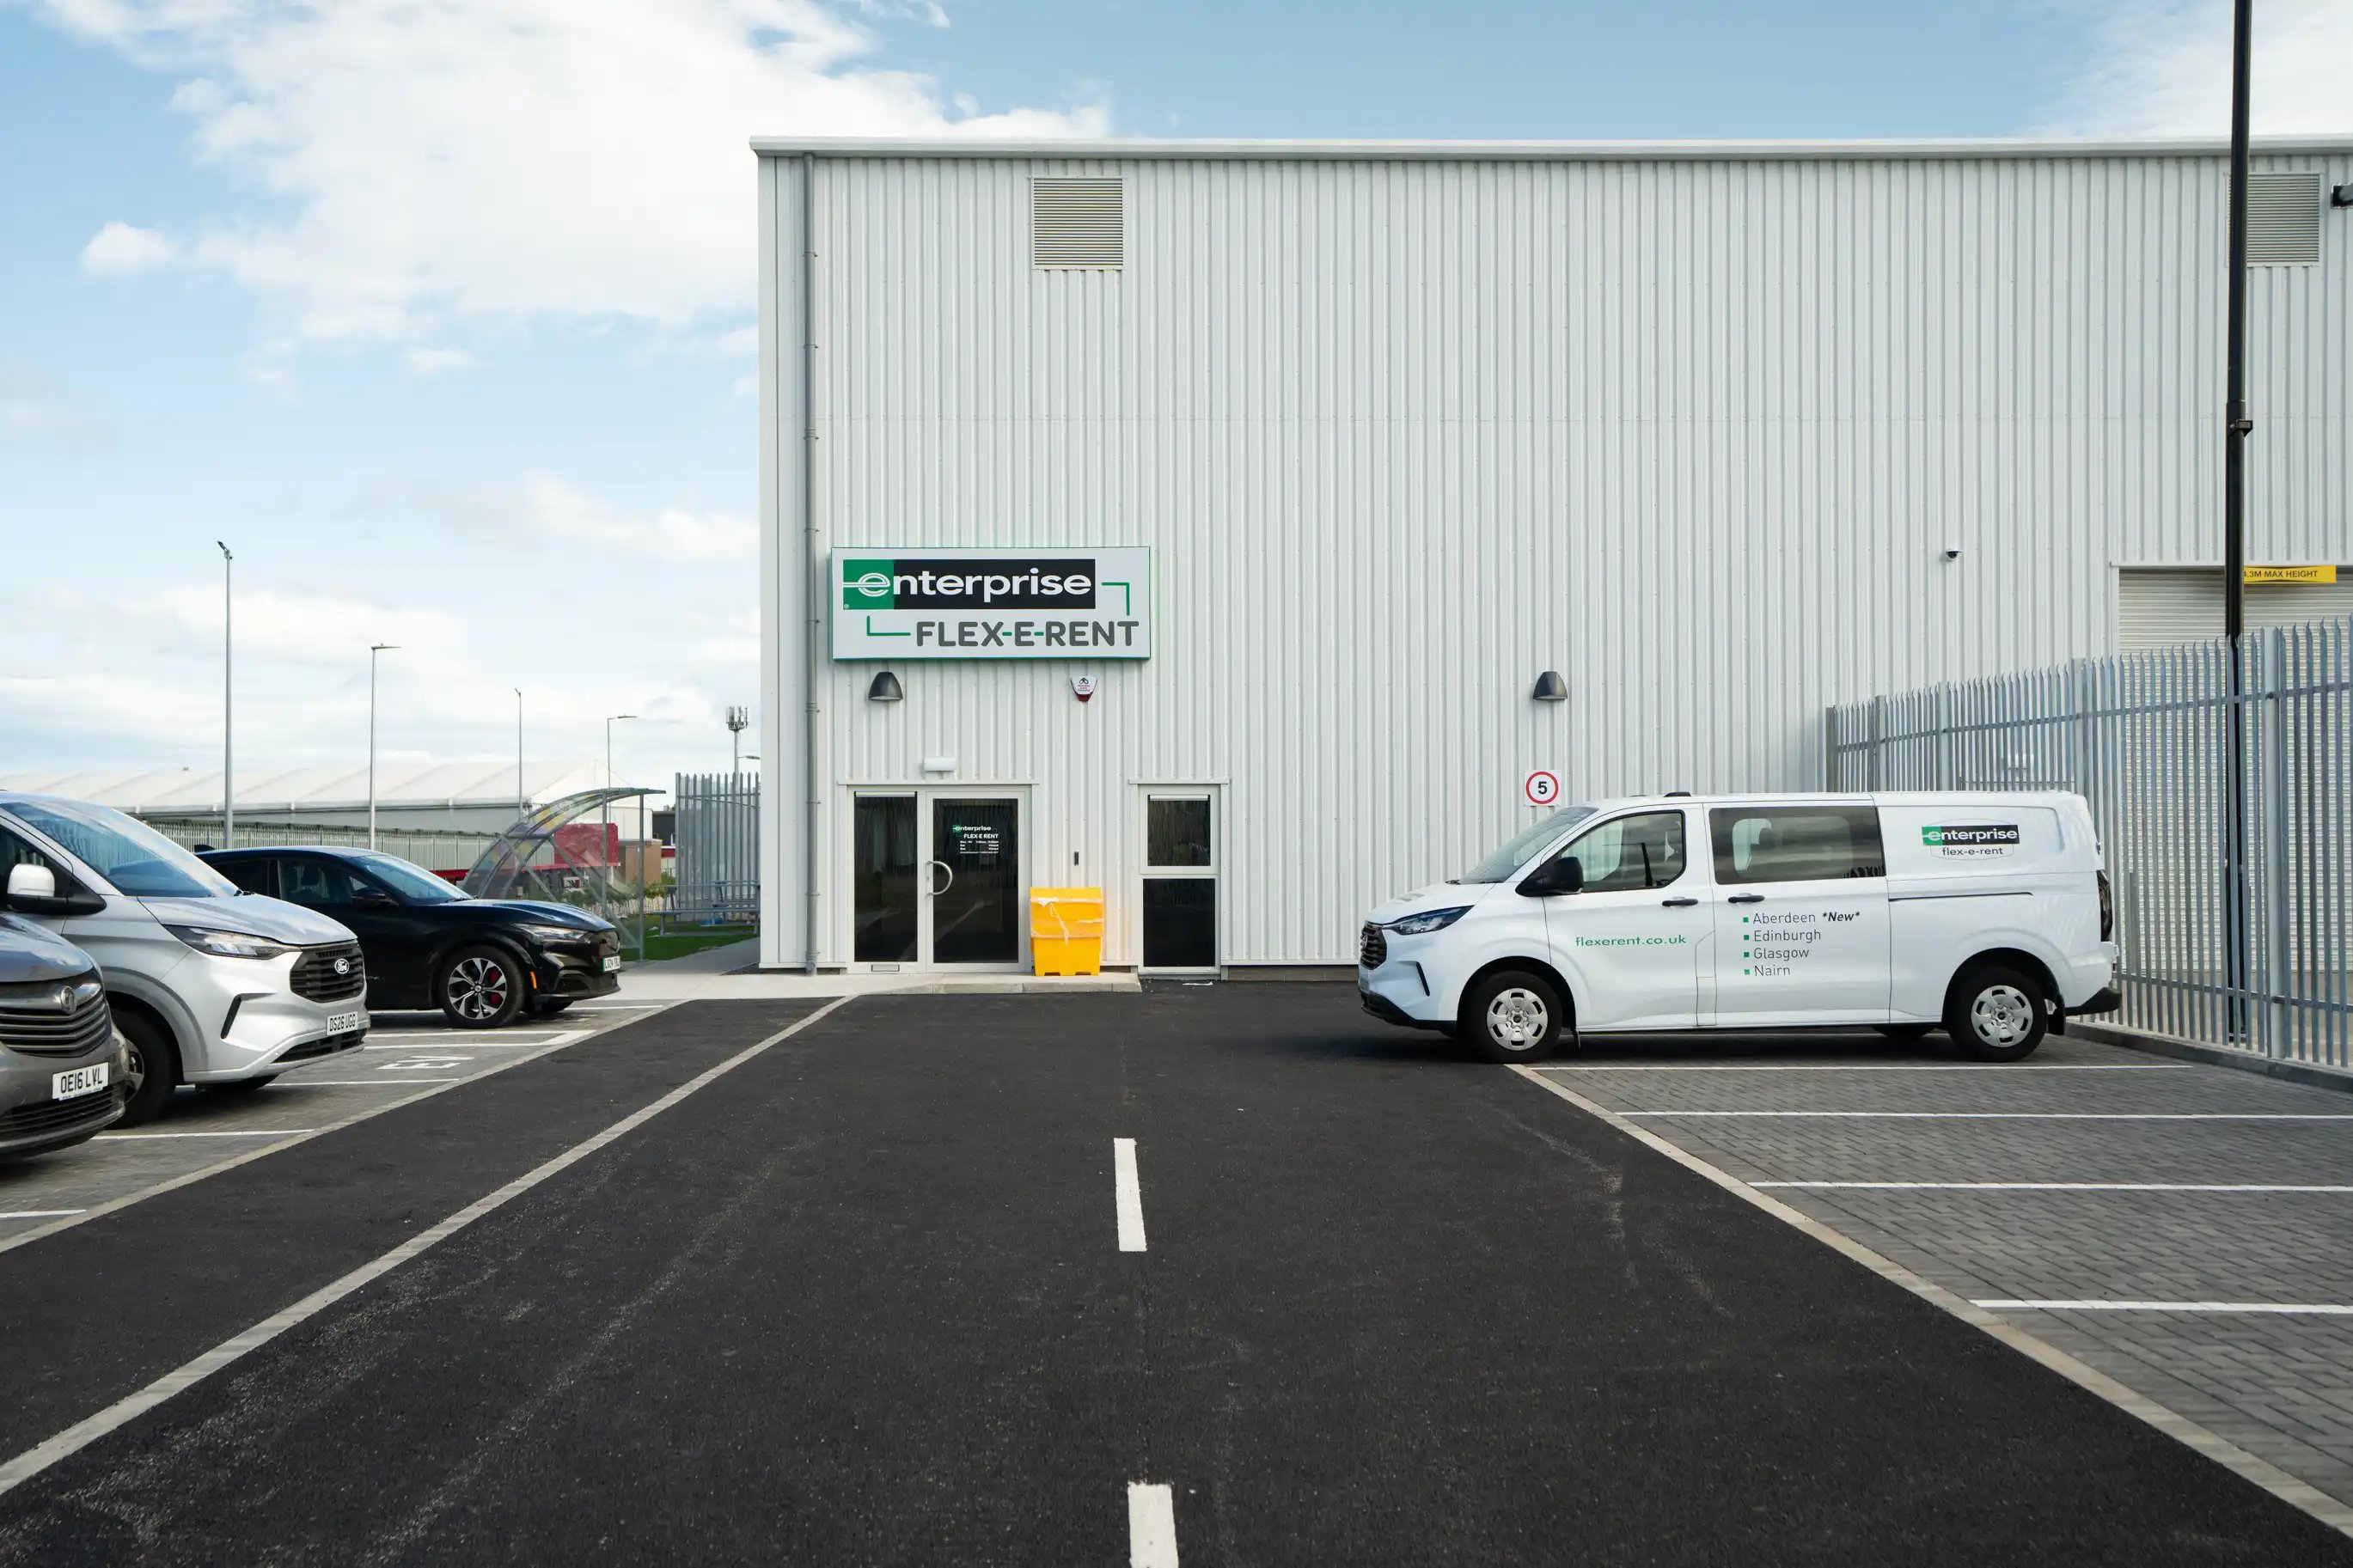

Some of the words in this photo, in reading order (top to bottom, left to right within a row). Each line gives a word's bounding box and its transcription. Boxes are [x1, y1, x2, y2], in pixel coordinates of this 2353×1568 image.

[856, 567, 1091, 603] enterprise
[916, 620, 1140, 647] FLEX-E-RENT
[1537, 780, 1548, 795] 5
[1928, 828, 2018, 842] enterprise
[1942, 847, 2004, 856] flex-e-rent
[1752, 912, 1816, 925] Aberdeen
[1574, 935, 1688, 948] flexerent.co.uk
[1753, 930, 1822, 944] Edinburgh
[1753, 948, 1810, 962] Glasgow
[1754, 966, 1791, 977] Nairn
[329, 1016, 345, 1032] DS26
[60, 1071, 83, 1094] OE16
[85, 1067, 102, 1088] LVL
